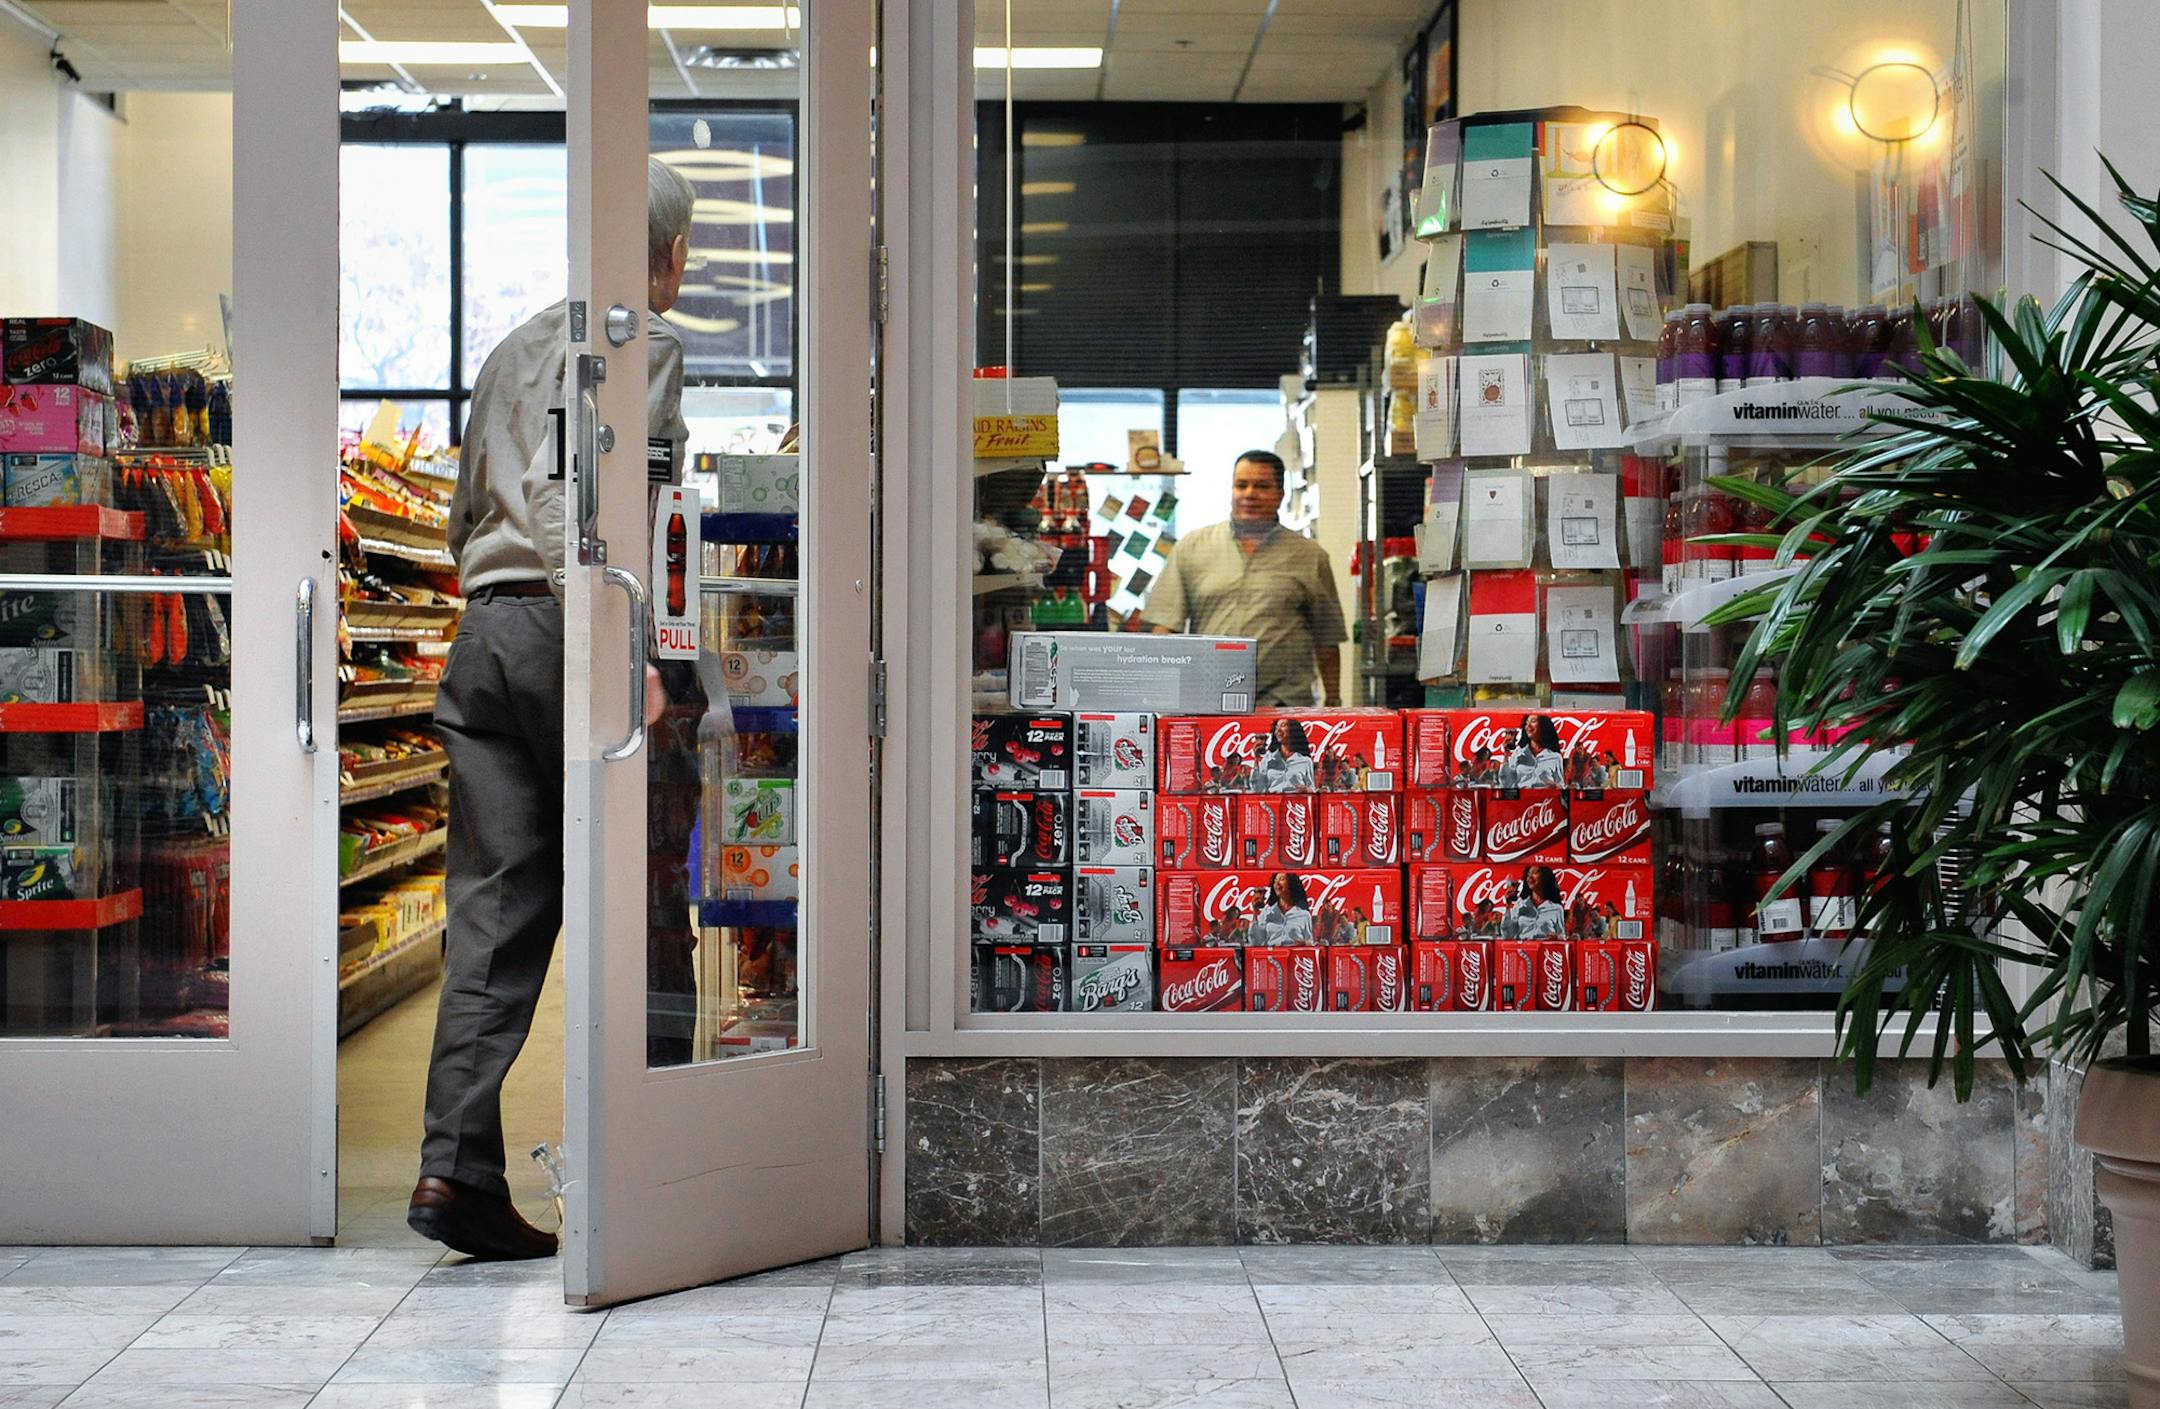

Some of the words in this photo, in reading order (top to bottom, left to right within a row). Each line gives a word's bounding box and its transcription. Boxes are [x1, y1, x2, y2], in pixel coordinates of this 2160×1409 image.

[24, 357, 57, 377] zero
[54, 387, 71, 399] 12
[1733, 402, 1839, 420] vitaminwater
[996, 418, 1047, 433] RAINS
[985, 432, 1030, 449] Fruit
[660, 628, 696, 650] PULL
[1102, 645, 1123, 654] your
[728, 658, 741, 671] 12
[1116, 654, 1159, 666] hydration
[1161, 655, 1192, 666] break?
[1026, 730, 1044, 743] 12
[1733, 776, 1839, 793] vitaminwater
[1859, 778, 1874, 792] all
[1053, 814, 1064, 847] zero
[1203, 801, 1224, 863] Coca-Cola
[1285, 801, 1307, 862] Coca-Cola
[1368, 800, 1389, 860] Coca-Cola
[1451, 795, 1473, 855] Coca-Cola
[1487, 798, 1555, 851] Coca-Cola
[1571, 798, 1638, 852] Coca-Cola
[732, 852, 744, 864] 12
[1534, 855, 1545, 863] 12
[1618, 855, 1629, 864] 12
[17, 879, 54, 902] Sprite
[1025, 884, 1043, 896] 12
[1052, 967, 1063, 1001] zero
[1162, 957, 1229, 1012] Coca-Cola
[1293, 953, 1314, 1012] Coca-Cola
[1376, 952, 1397, 1012] Coca-Cola
[1460, 948, 1480, 1008] Coca-Cola
[1543, 948, 1563, 1008] Coca-Cola
[1625, 948, 1646, 1009] Coca-Cola
[1079, 967, 1141, 1012] Barq's
[1128, 1001, 1144, 1011] 12
